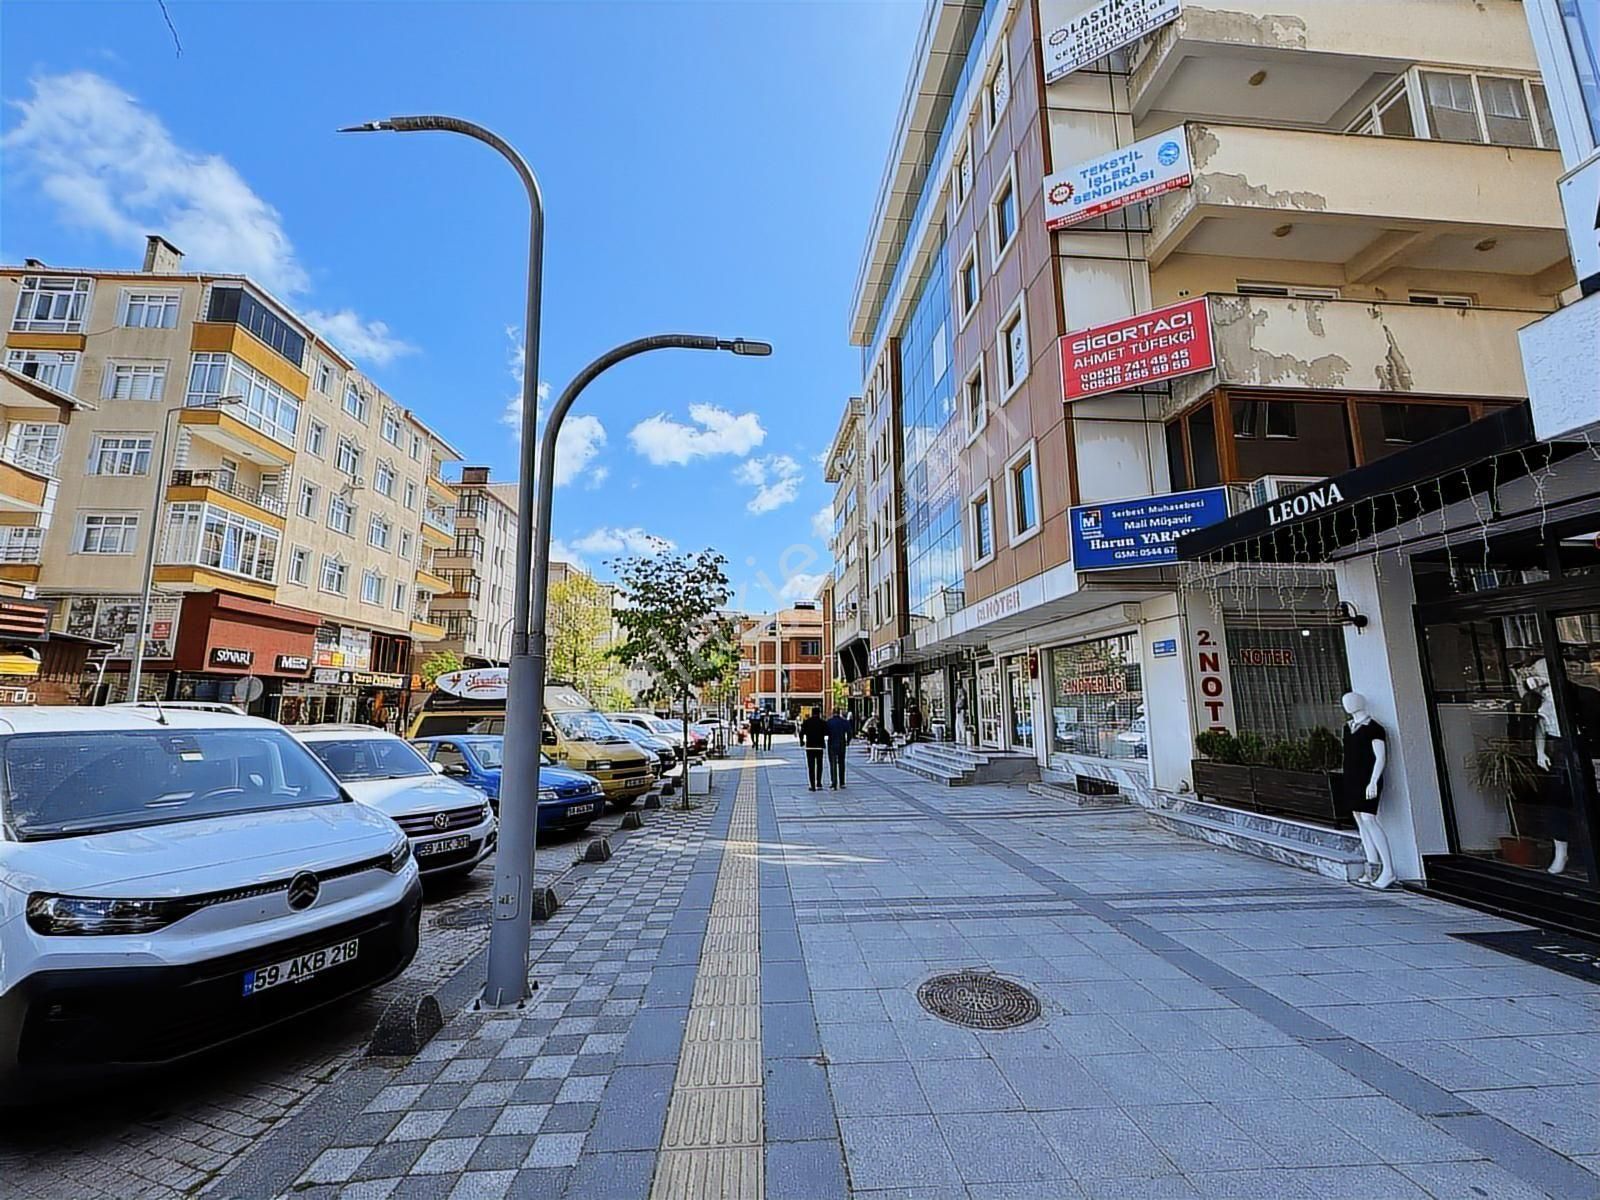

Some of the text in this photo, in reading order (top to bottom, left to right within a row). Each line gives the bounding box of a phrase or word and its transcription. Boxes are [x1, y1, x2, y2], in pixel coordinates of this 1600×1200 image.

[1080, 151, 1143, 179] TEKSTİL
[1089, 163, 1136, 189] İŞLERİ
[1073, 169, 1154, 206] SENDİKASI
[1072, 311, 1192, 354] SİGORTACI
[1073, 327, 1196, 370] AHMET TÜFEKÇİ
[1111, 508, 1145, 518] Serbest
[1268, 483, 1344, 526] LEONA
[1124, 514, 1192, 530] Mali Müşavir
[1090, 527, 1201, 550] Harun YARA
[1163, 546, 1178, 555] 67
[1197, 630, 1217, 646] 2.
[1240, 648, 1294, 667] NOTER
[1199, 652, 1227, 731] NOT
[254, 940, 358, 990] 59 AKB 218
